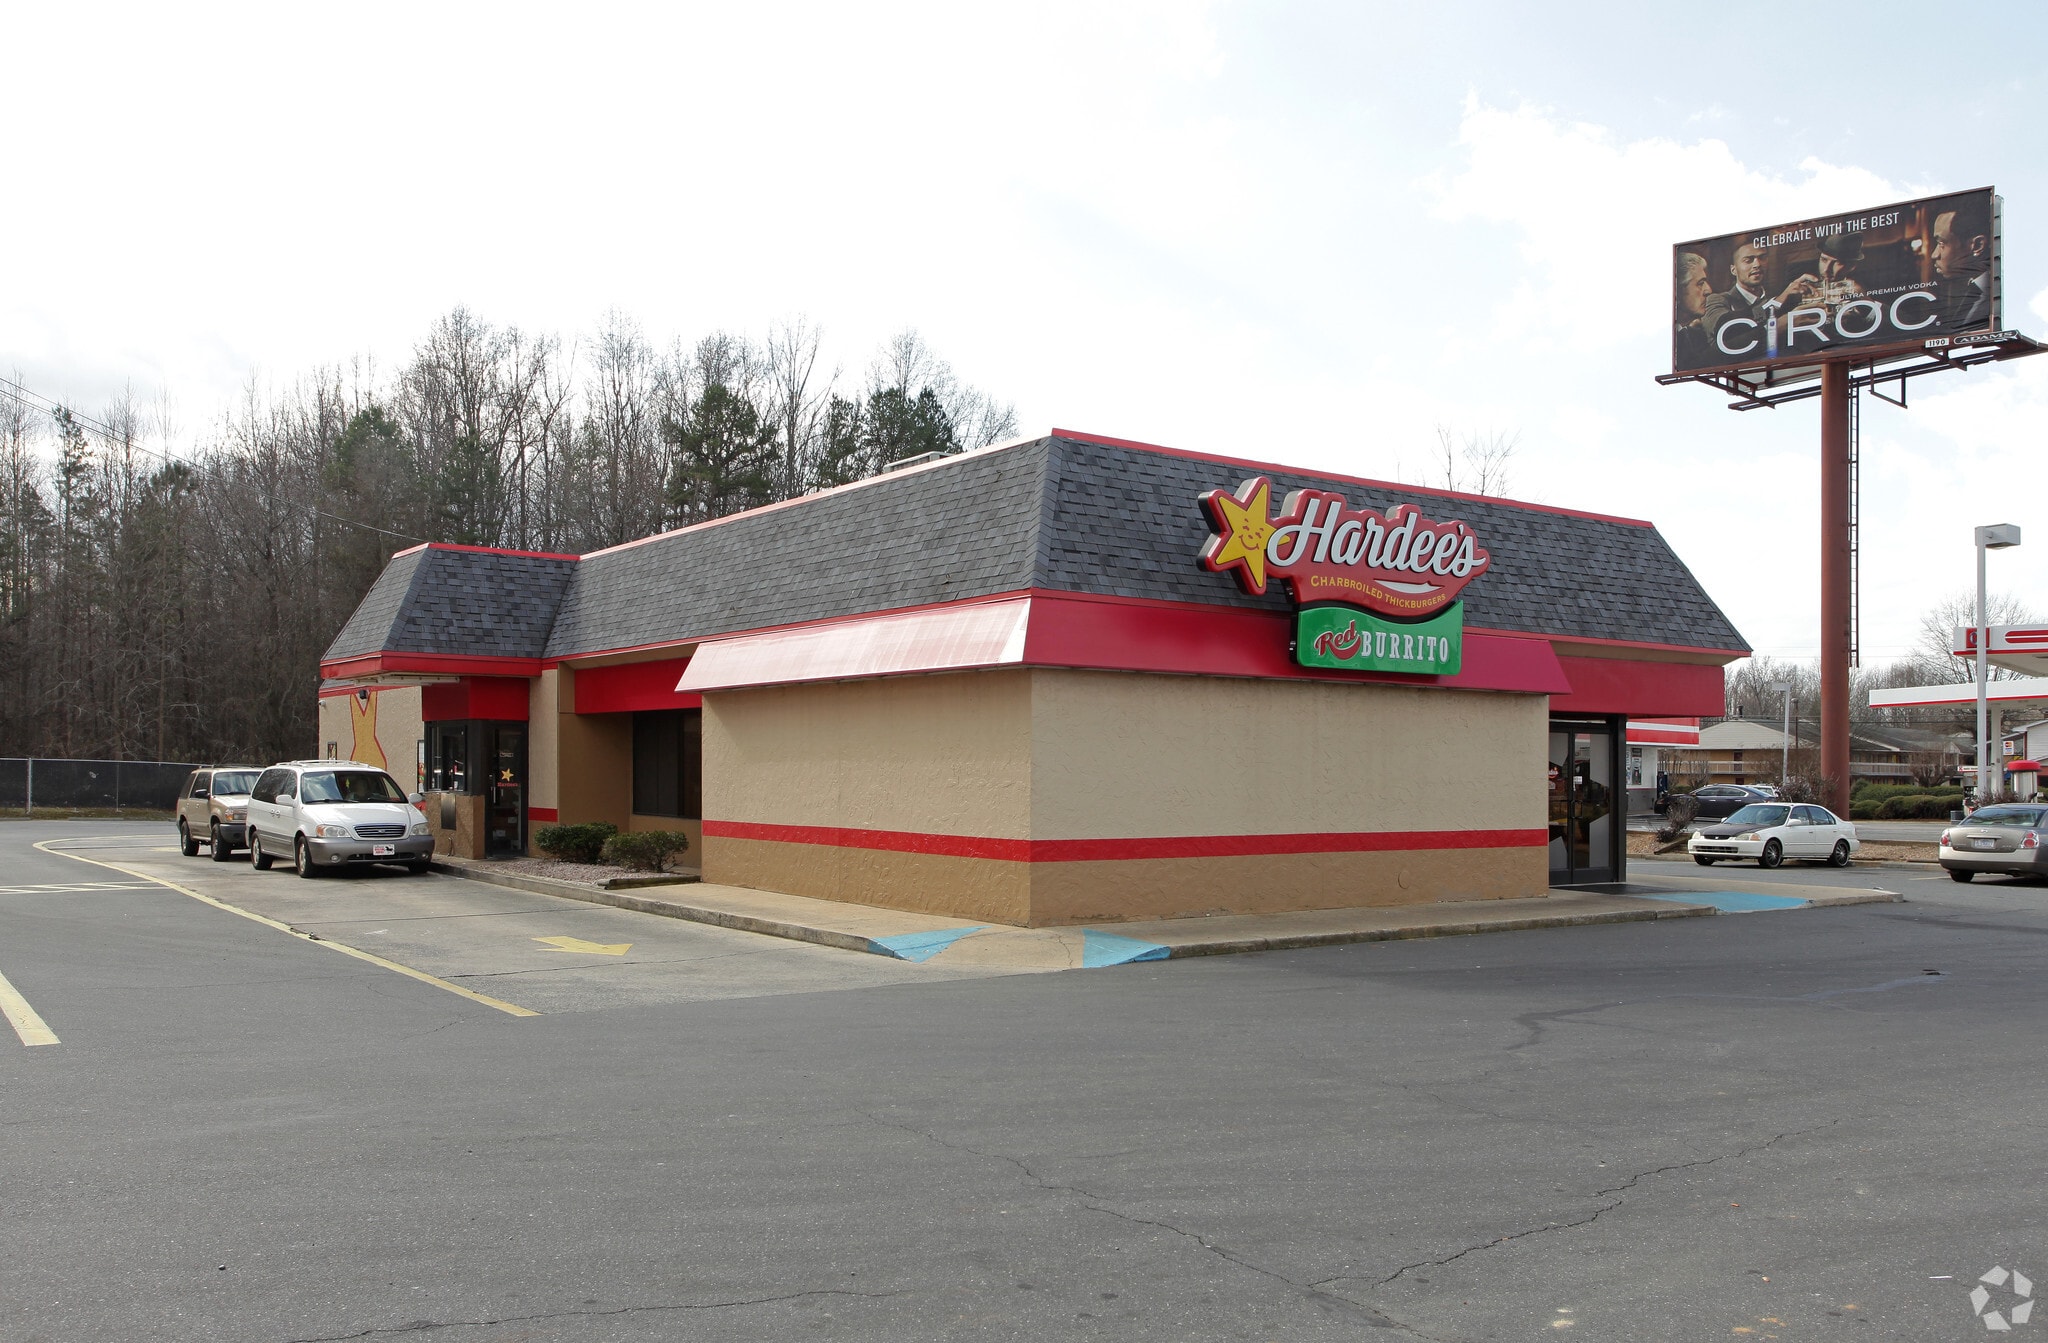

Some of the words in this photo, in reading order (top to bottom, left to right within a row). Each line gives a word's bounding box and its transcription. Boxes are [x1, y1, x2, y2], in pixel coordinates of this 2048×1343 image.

[1753, 228, 1811, 249] CELEBRATE
[1815, 222, 1842, 238] WITH
[1846, 217, 1867, 232] THE
[1871, 212, 1900, 228] BEST
[1866, 286, 1906, 296] PREMIUM
[1908, 281, 1938, 290] VODKA
[1929, 339, 1946, 347] 1190
[1960, 331, 2013, 343] ADAMS
[1267, 498, 1486, 578] Hardee's
[1310, 575, 1383, 599] CHARBROILED
[1385, 593, 1447, 609] THICKBURGERS
[1314, 619, 1361, 660] Red
[1361, 631, 1449, 663] BURRITO
